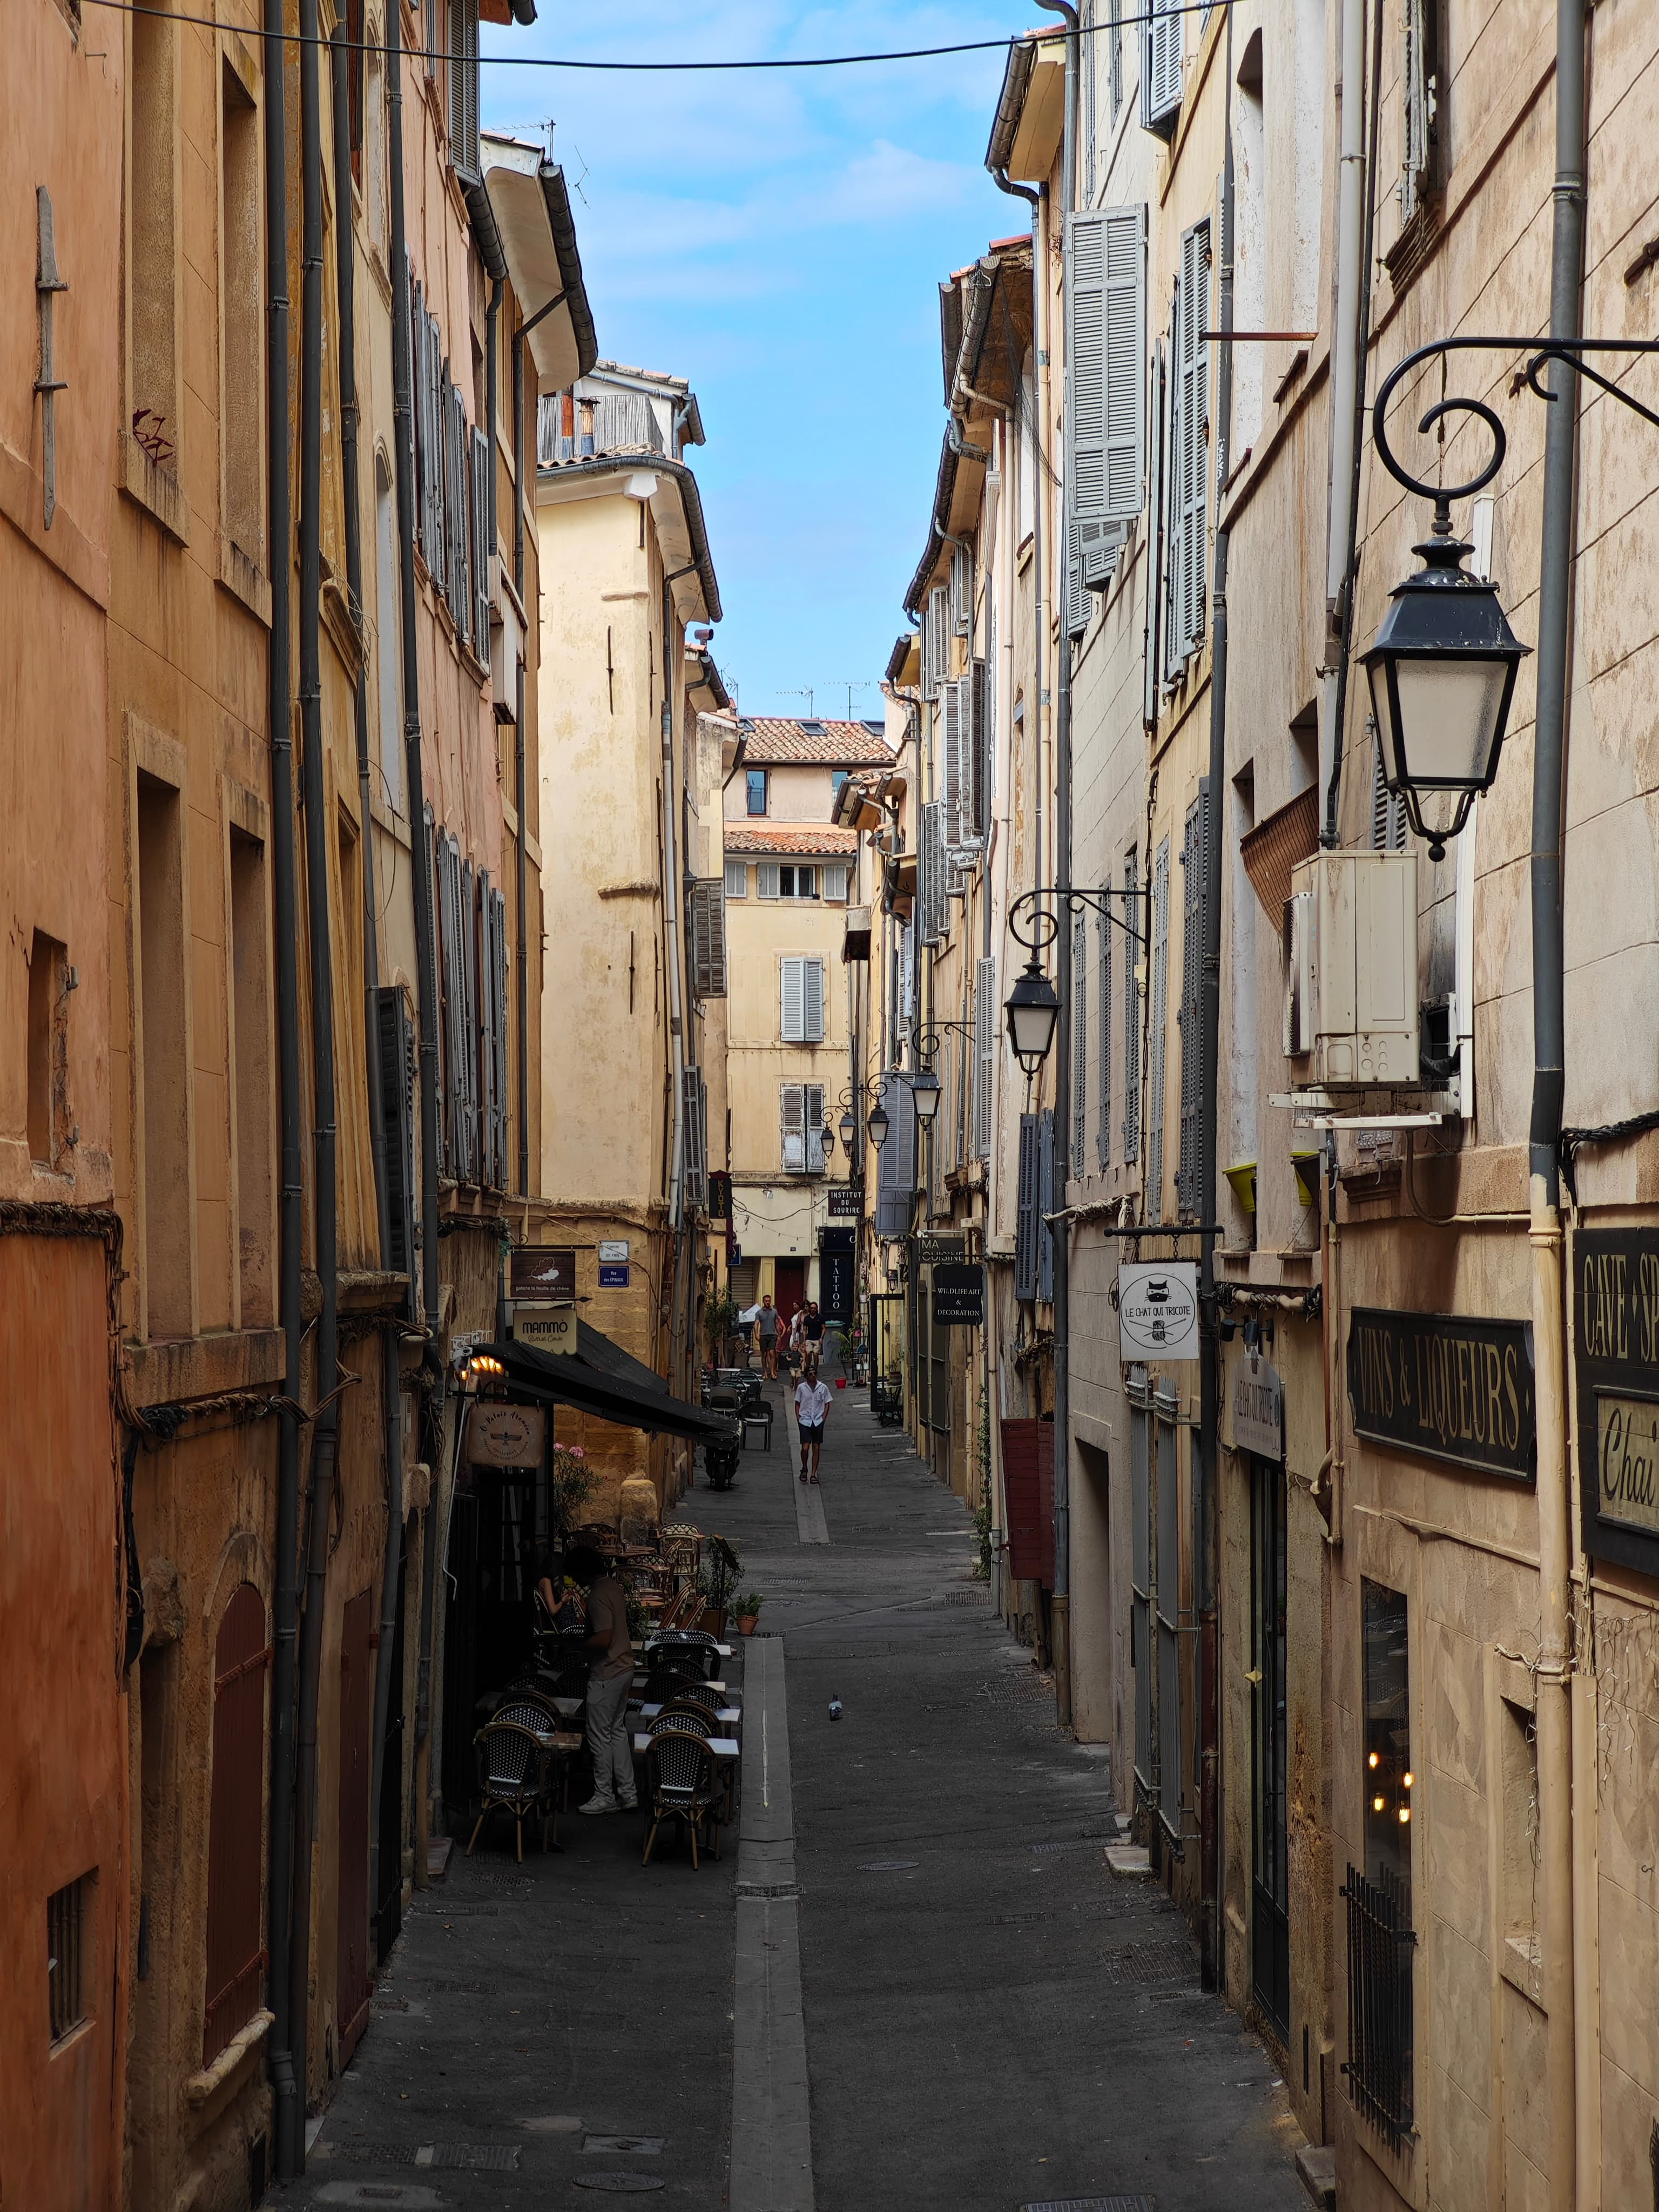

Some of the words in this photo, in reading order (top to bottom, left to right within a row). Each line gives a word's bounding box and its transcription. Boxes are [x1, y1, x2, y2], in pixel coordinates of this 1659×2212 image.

[922, 1239, 939, 1249] MA
[922, 1251, 964, 1261] CUISINE
[1125, 1308, 1134, 1317] LE
[1135, 1307, 1151, 1317] CHAT
[1153, 1307, 1163, 1316] QUI
[1165, 1306, 1191, 1316] TRICOTE
[1584, 1253, 1628, 1360] CAVE
[1358, 1326, 1393, 1419] VINS
[1399, 1337, 1411, 1406] &
[1415, 1333, 1519, 1451] LIQUEURS
